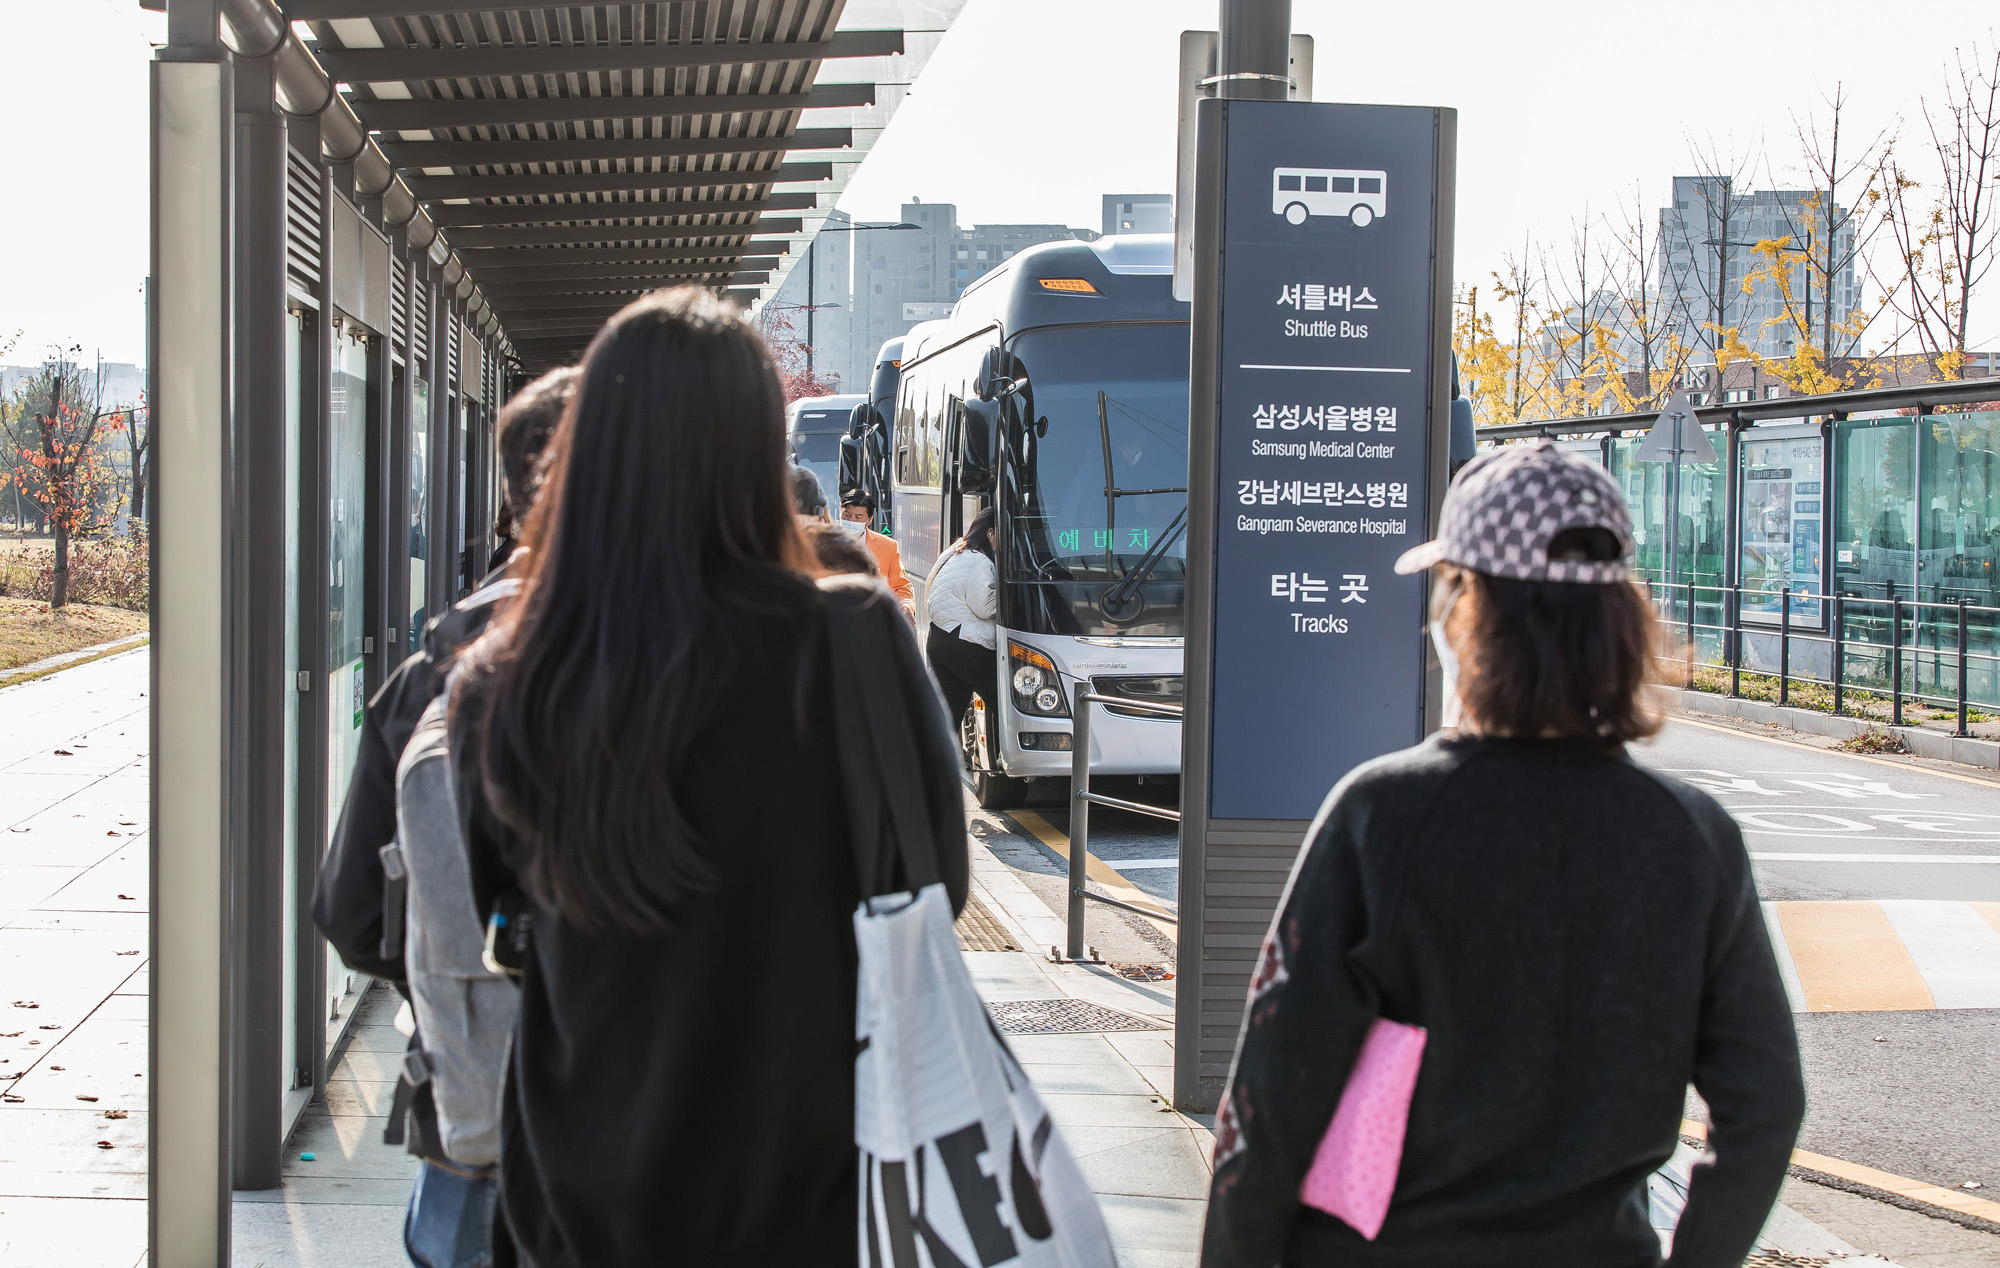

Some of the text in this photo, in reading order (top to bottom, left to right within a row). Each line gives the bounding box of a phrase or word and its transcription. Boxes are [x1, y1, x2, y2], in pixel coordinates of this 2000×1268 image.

[1276, 283, 1379, 312] 셔틀버스
[1284, 318, 1369, 339] Shuttle Bus
[1251, 403, 1398, 433] 삼성서울병원
[1251, 438, 1396, 461] Samsung Medical Center
[1237, 479, 1408, 509] 강남세브란스병원
[1237, 514, 1407, 538] Gangnam Severance Hospital
[1271, 571, 1370, 604] 타는 곳
[1290, 612, 1349, 634] Tracks
